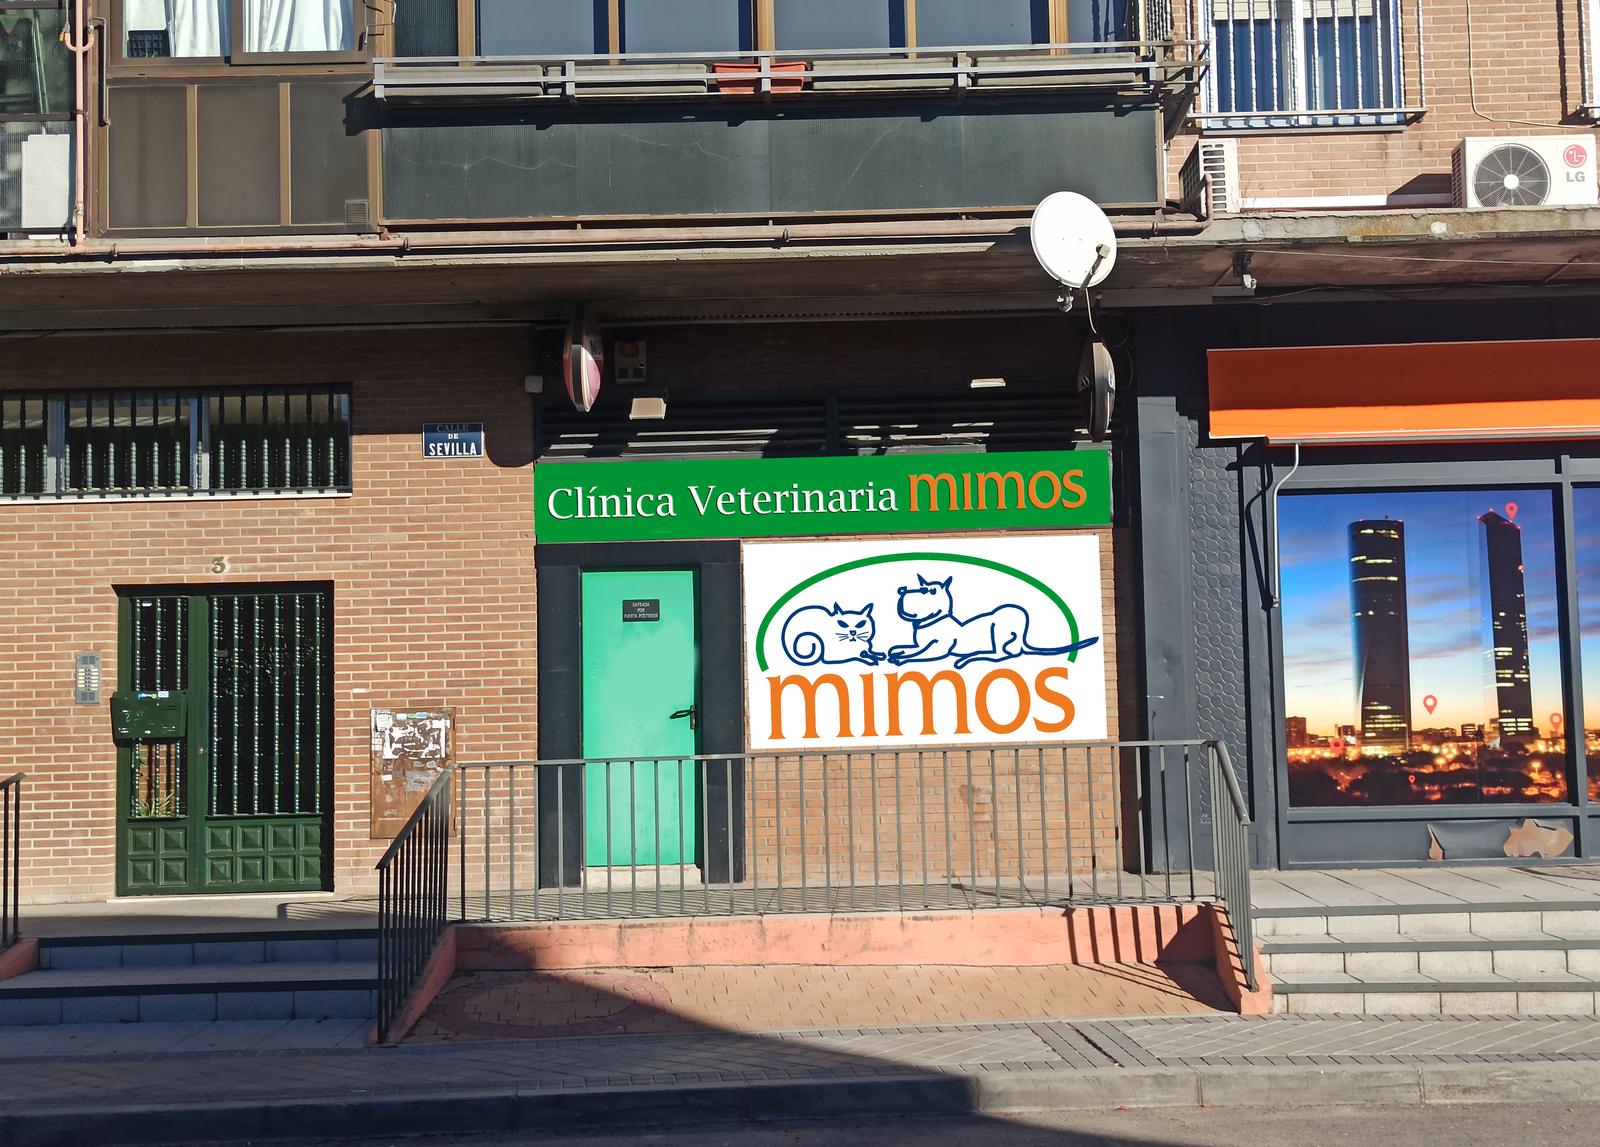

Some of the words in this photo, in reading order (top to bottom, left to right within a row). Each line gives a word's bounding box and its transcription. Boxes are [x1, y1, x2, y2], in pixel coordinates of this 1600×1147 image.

[1566, 171, 1585, 182] LG
[436, 424, 469, 433] CALLE
[429, 442, 477, 456] SEVILLA
[548, 486, 677, 520] Clínica
[688, 481, 898, 516] Veterinaria
[908, 469, 1087, 512] mimos
[767, 667, 1076, 740] mimos
